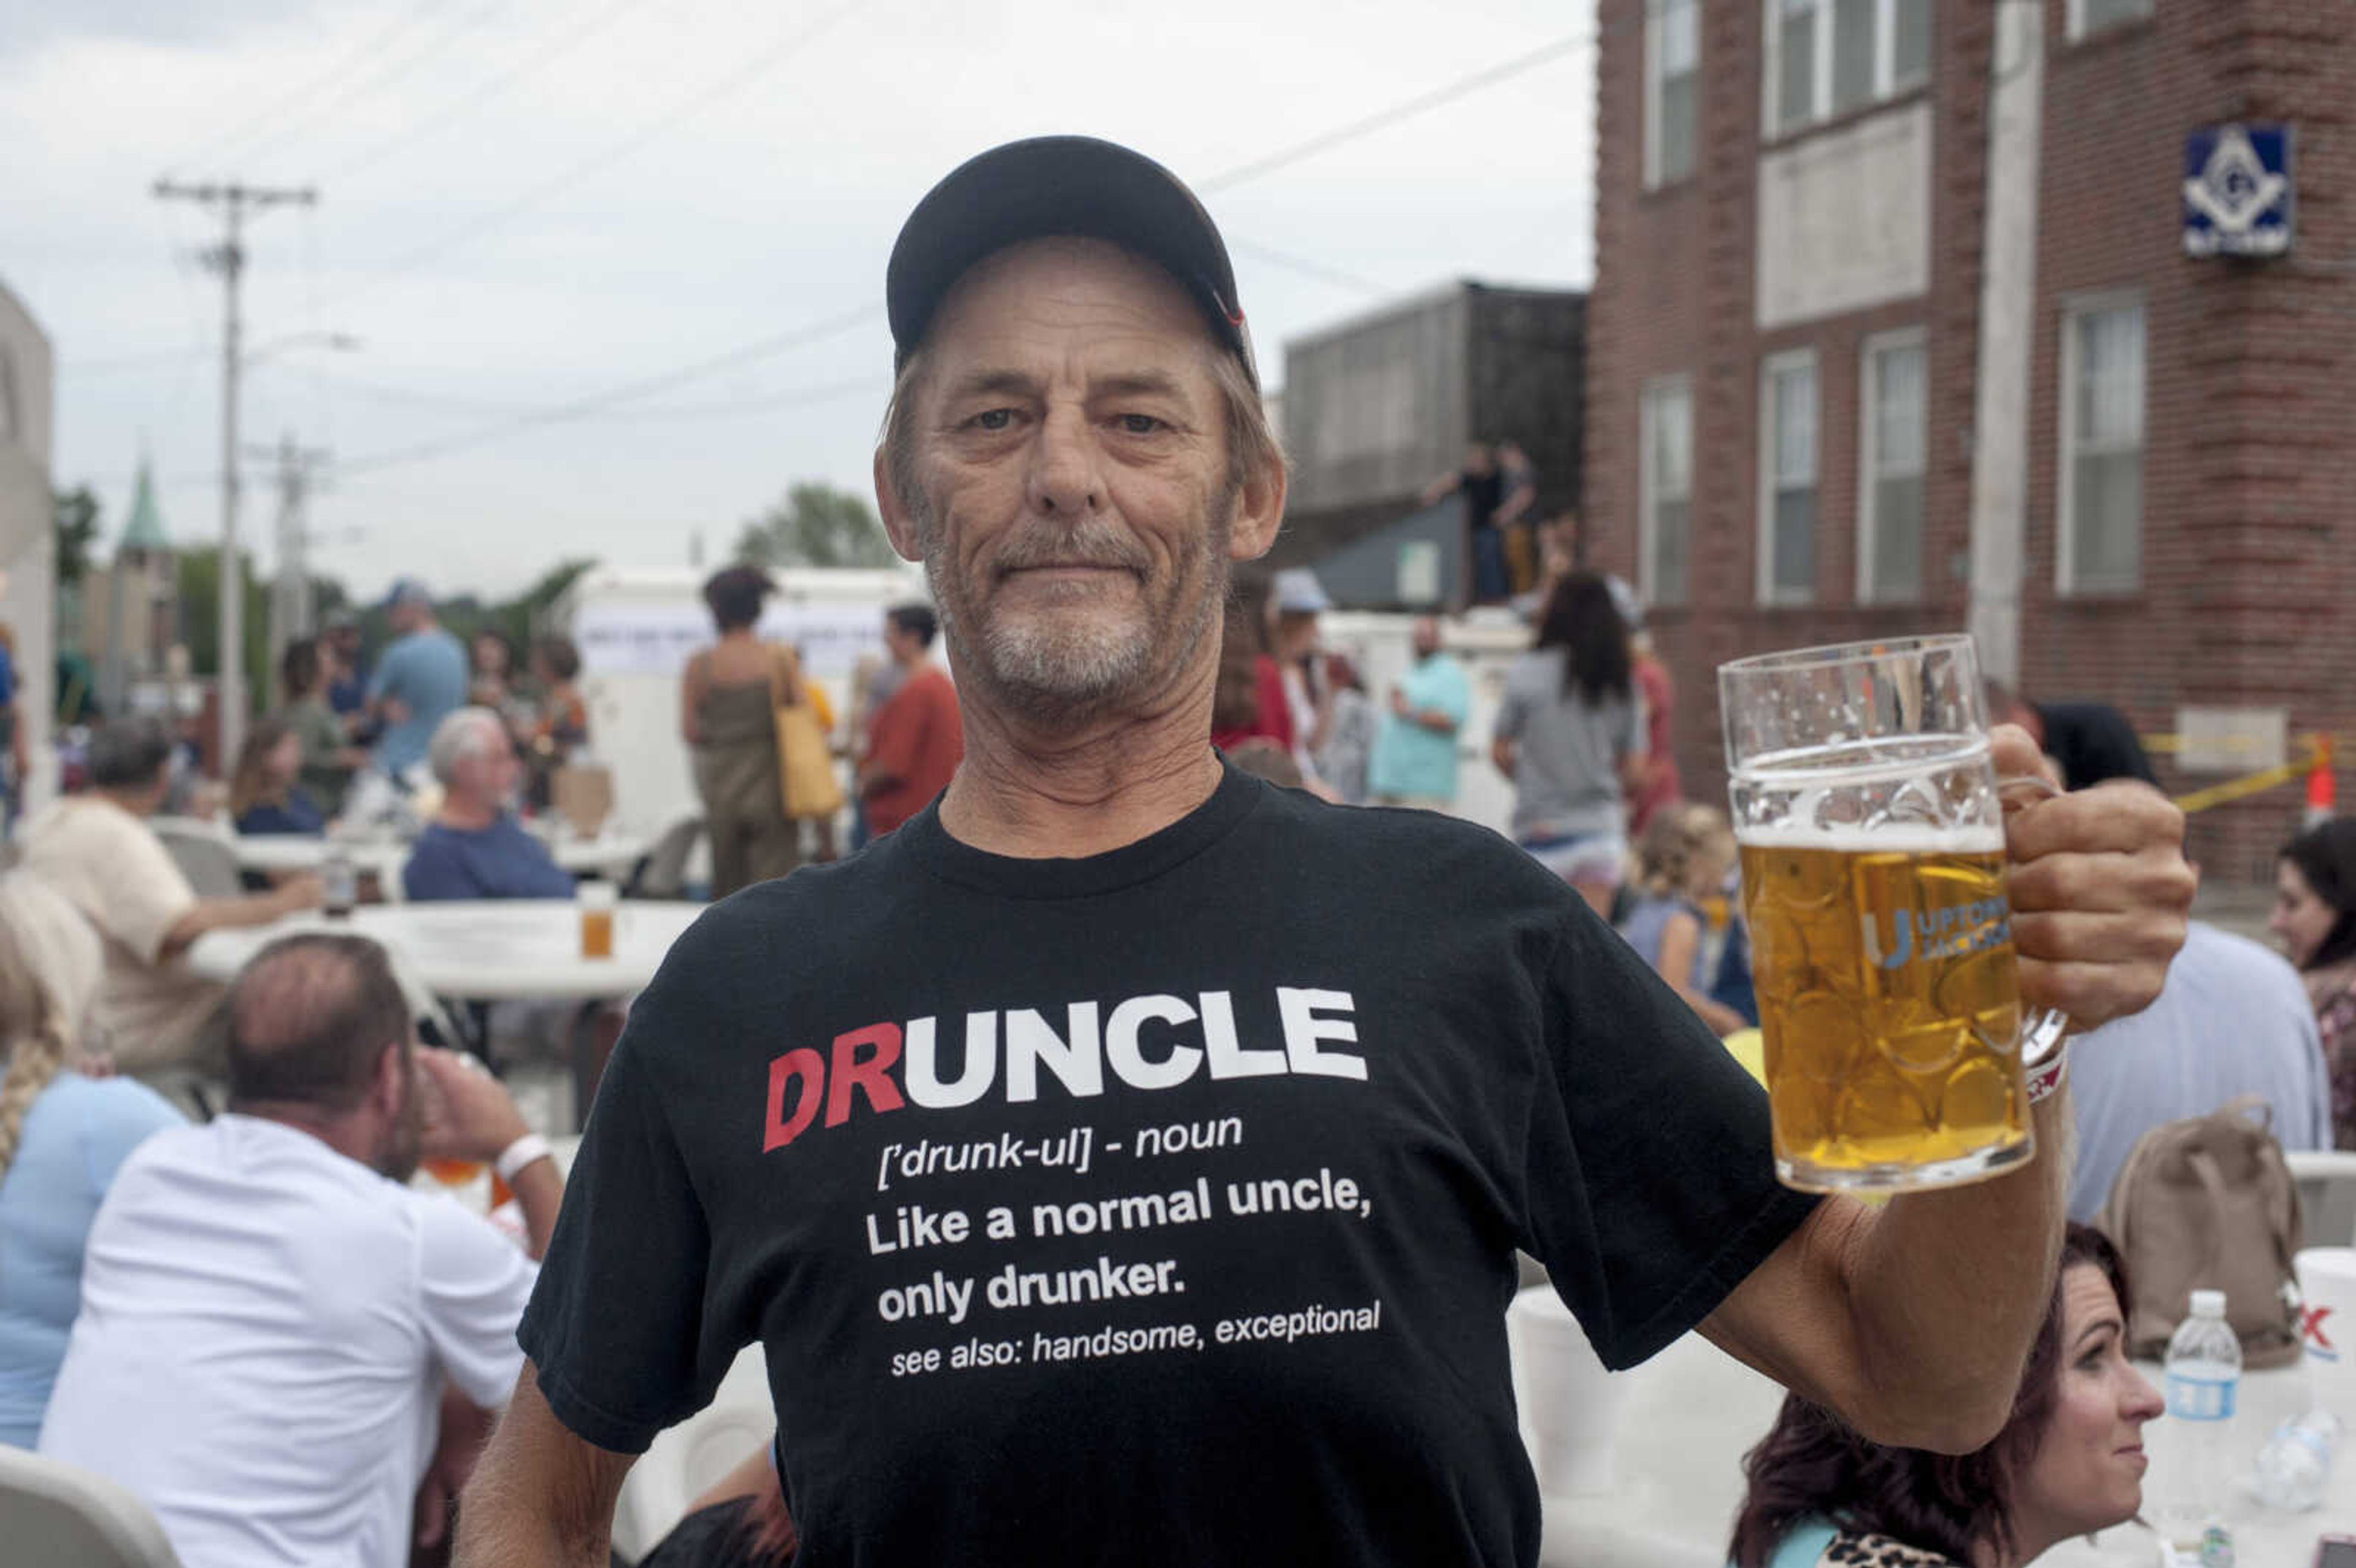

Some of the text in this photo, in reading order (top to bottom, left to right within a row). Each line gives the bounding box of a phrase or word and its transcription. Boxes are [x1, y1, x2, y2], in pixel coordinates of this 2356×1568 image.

[763, 986, 1368, 1154] DRUNCLE
[1135, 1116, 1242, 1158] noun
[866, 1167, 1371, 1255] Like a normal uncle,
[878, 1256, 1185, 1324] only drunker.
[891, 1300, 1381, 1377] see also: handsome, exceptional
